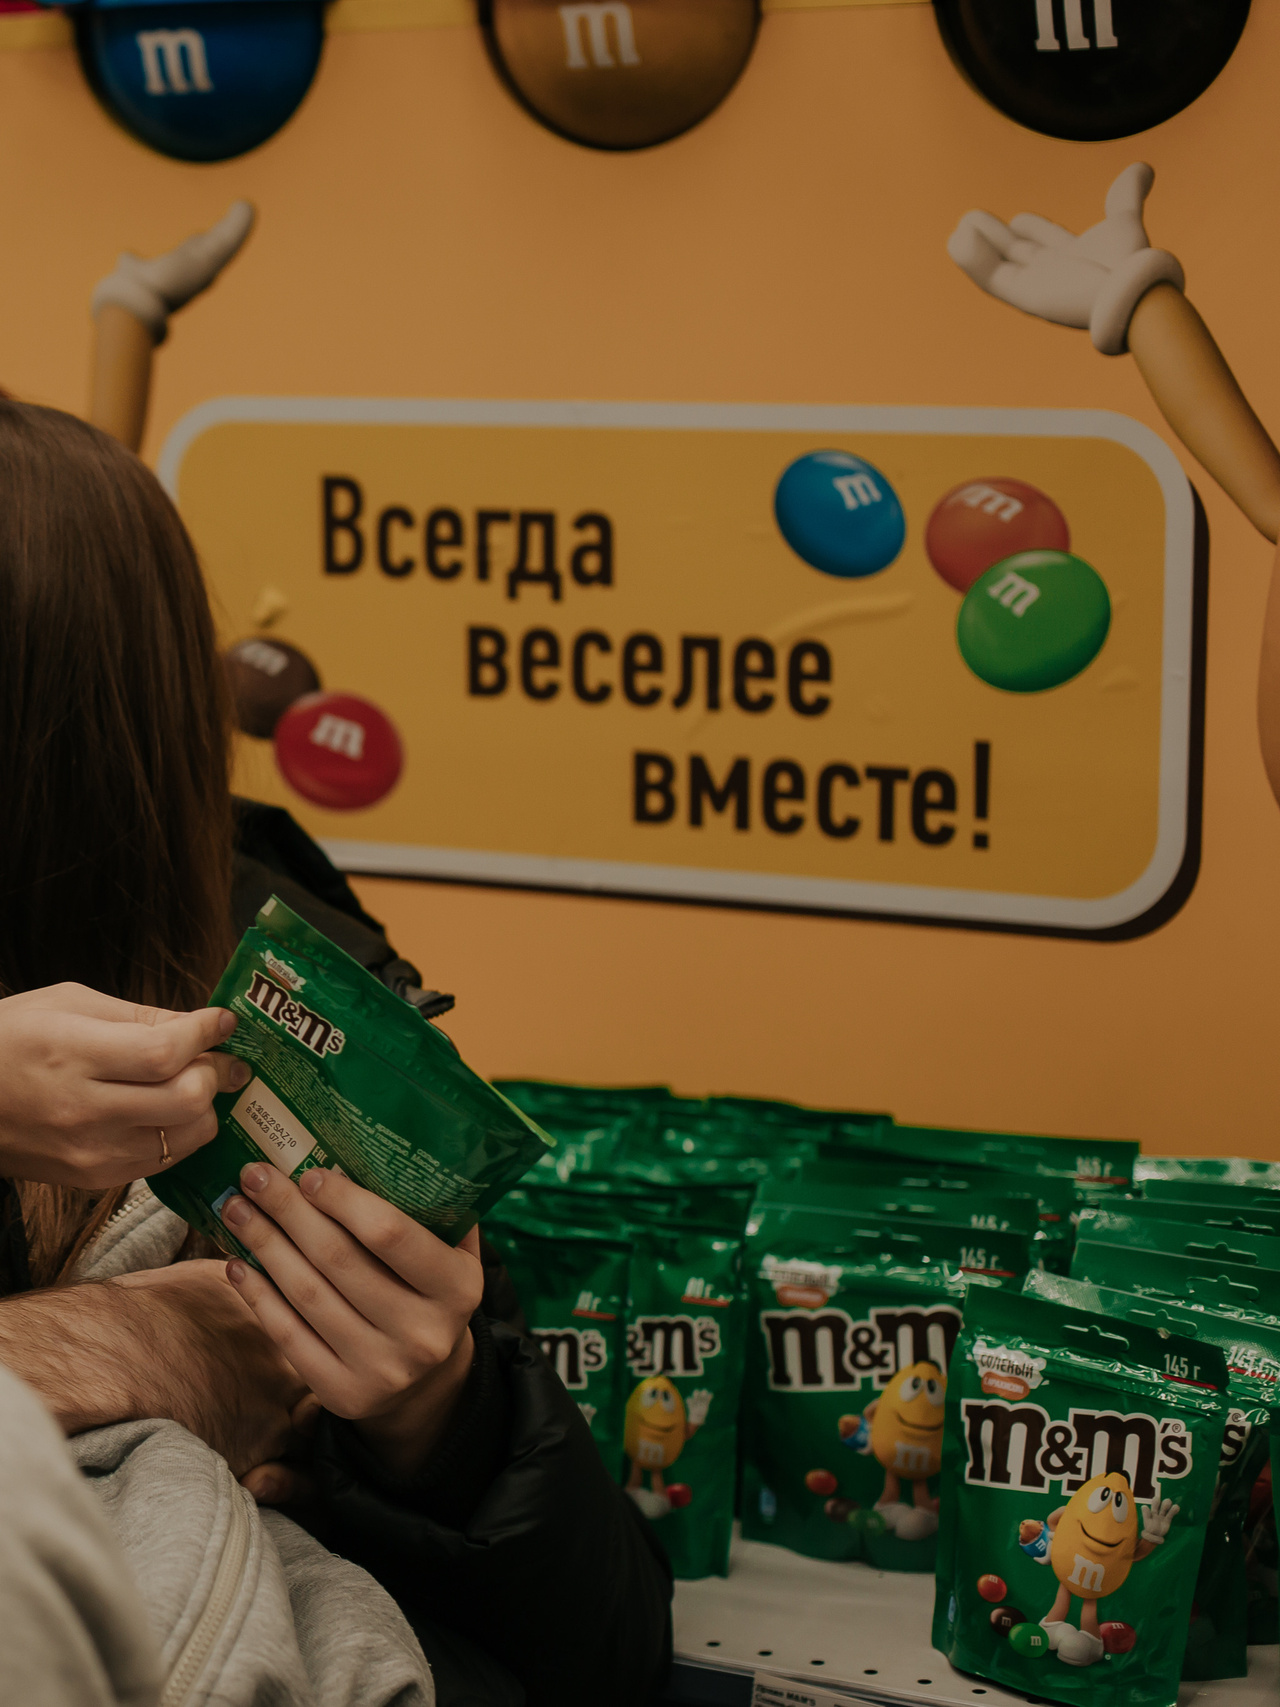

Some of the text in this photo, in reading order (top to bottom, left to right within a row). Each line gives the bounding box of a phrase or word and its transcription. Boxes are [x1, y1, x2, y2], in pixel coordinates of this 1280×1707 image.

[138, 28, 214, 95] m
[560, 1, 641, 69] m
[832, 472, 882, 511] m
[321, 475, 616, 603] Всегда
[987, 572, 1041, 618] m
[466, 624, 833, 718] веселее
[632, 740, 992, 851] вместе!
[269, 1132, 285, 1150] 07:41
[287, 1138, 296, 1147] 10
[627, 1318, 717, 1373] &m's
[765, 1310, 962, 1385] m&m
[1163, 1353, 1201, 1380] 145 г
[1068, 1553, 1106, 1593] m
